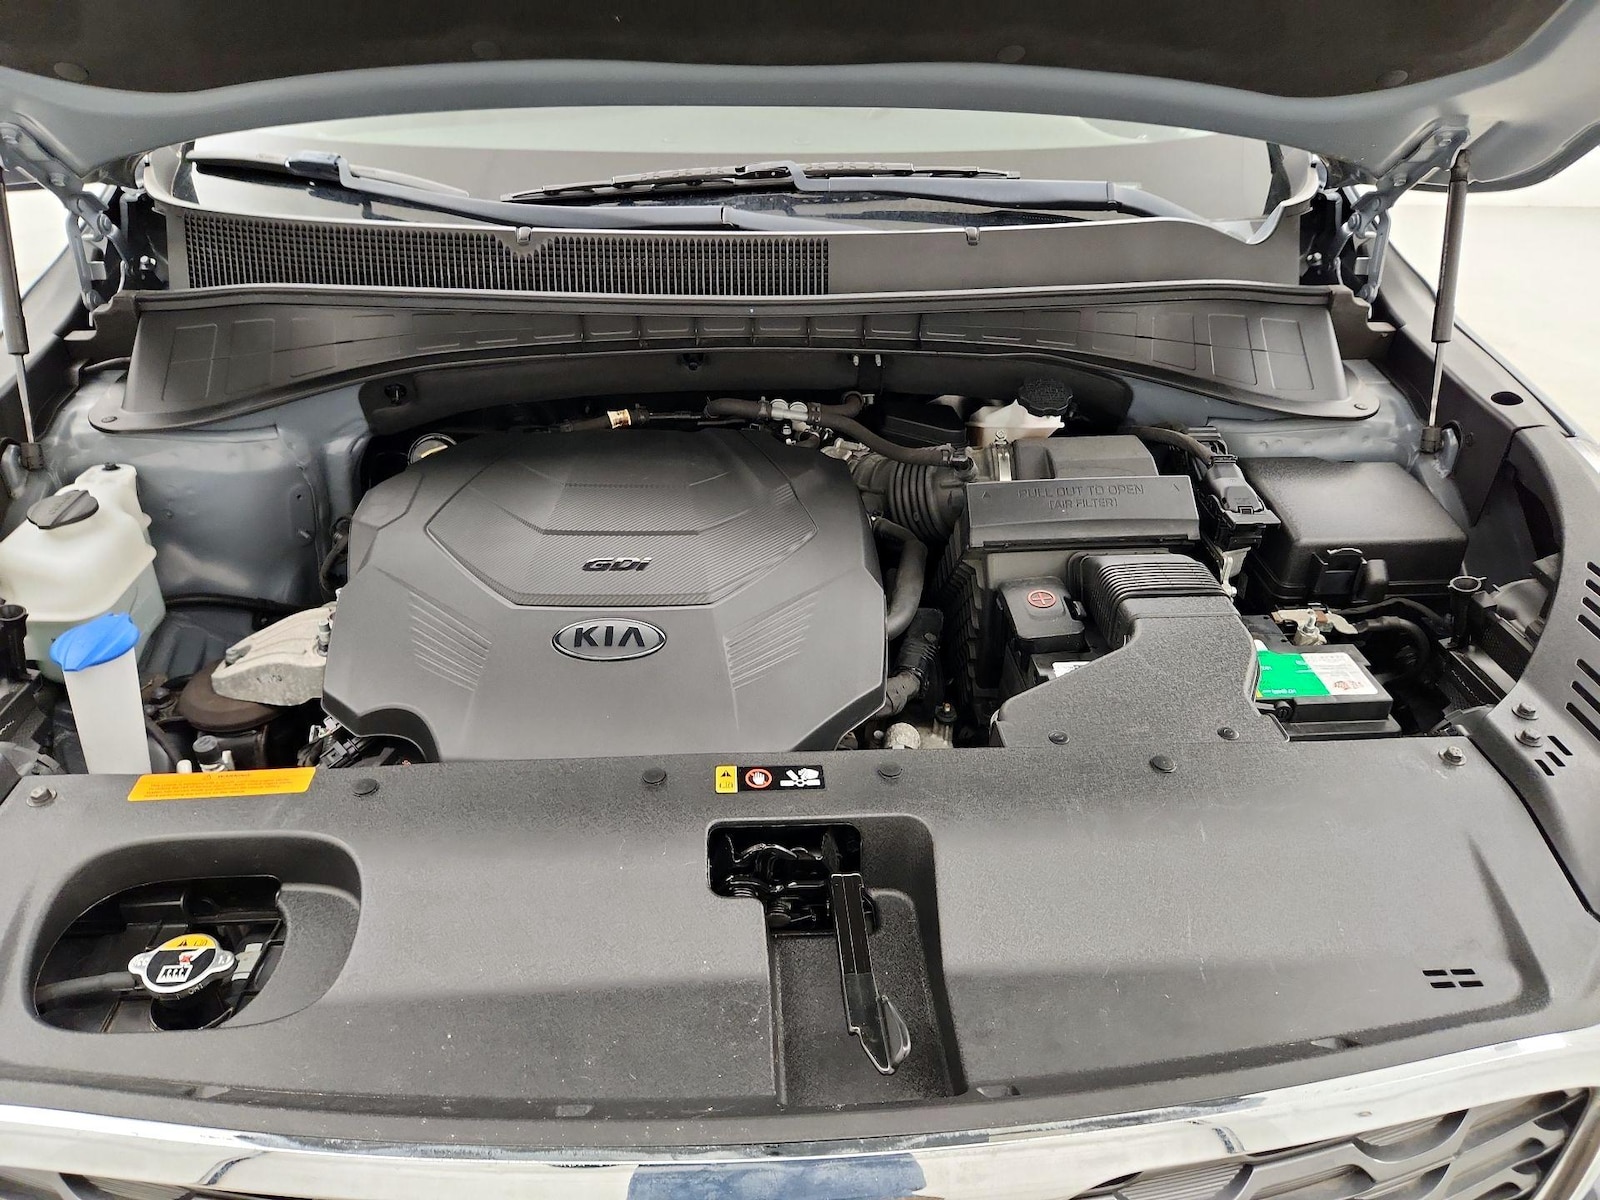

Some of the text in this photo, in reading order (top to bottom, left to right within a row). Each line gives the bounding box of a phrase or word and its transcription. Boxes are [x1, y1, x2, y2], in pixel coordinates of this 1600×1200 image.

[1017, 483, 1145, 499] PULL OUT TO OPEN
[573, 625, 645, 648] KIA
